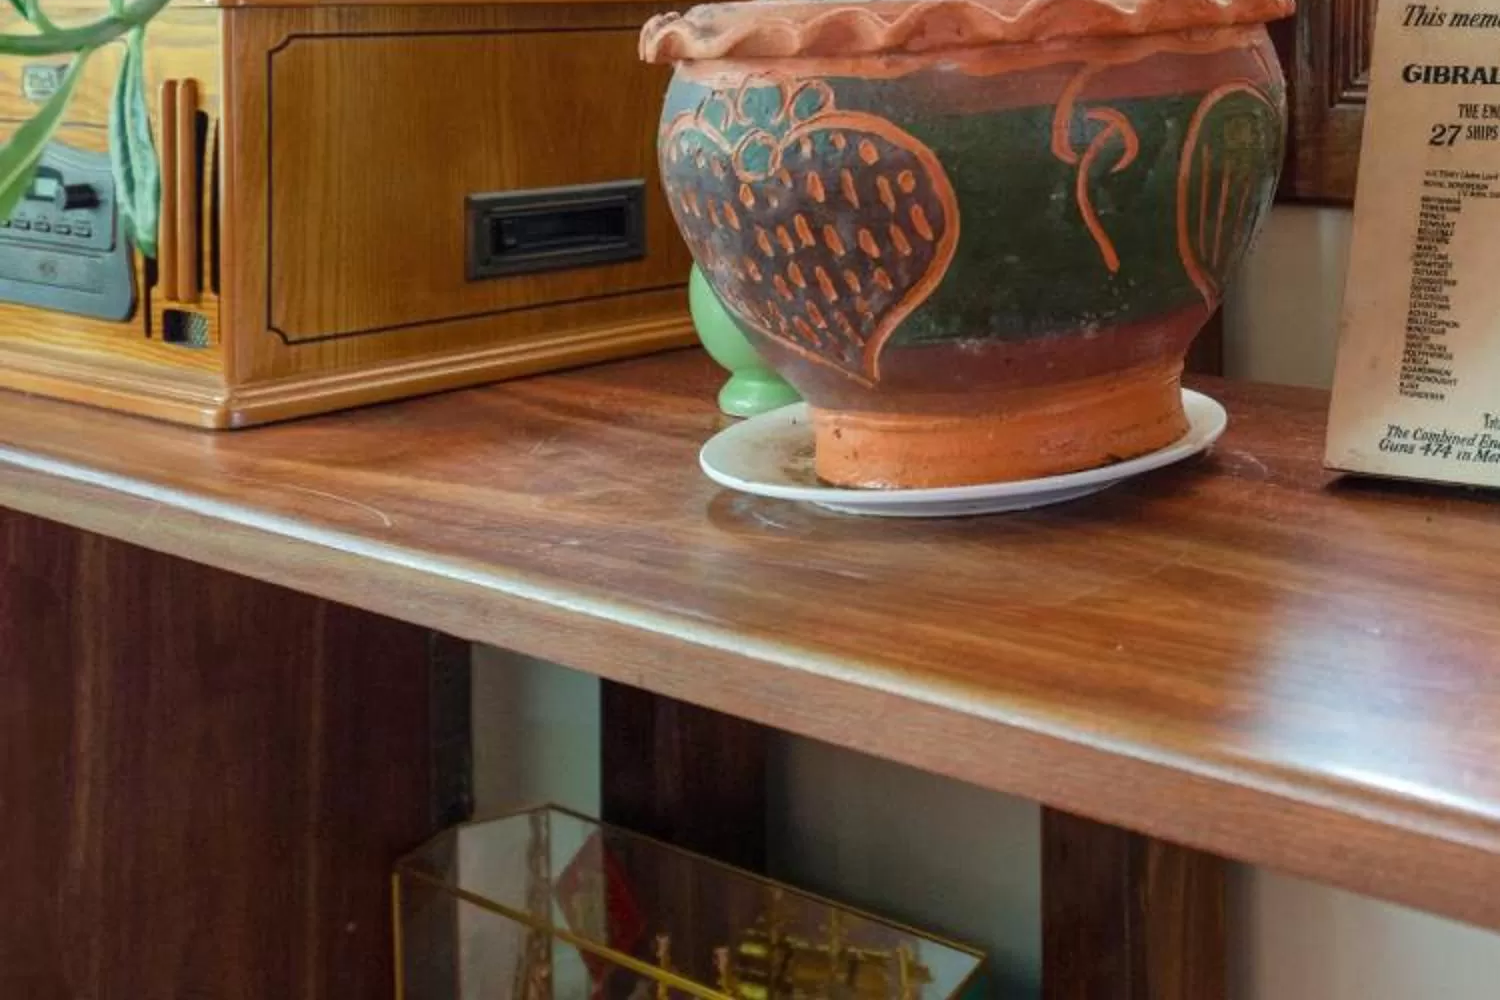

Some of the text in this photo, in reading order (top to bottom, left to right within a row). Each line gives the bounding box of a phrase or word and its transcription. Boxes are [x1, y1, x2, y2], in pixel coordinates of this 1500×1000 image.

[1401, 4, 1446, 29] This
[1458, 103, 1478, 119] THE
[1428, 124, 1462, 147] 27
[1465, 125, 1498, 140] SHIPS
[1386, 424, 1409, 439] The
[1413, 427, 1478, 447] Combined
[1378, 438, 1416, 455] Guns
[1456, 450, 1471, 461] in
